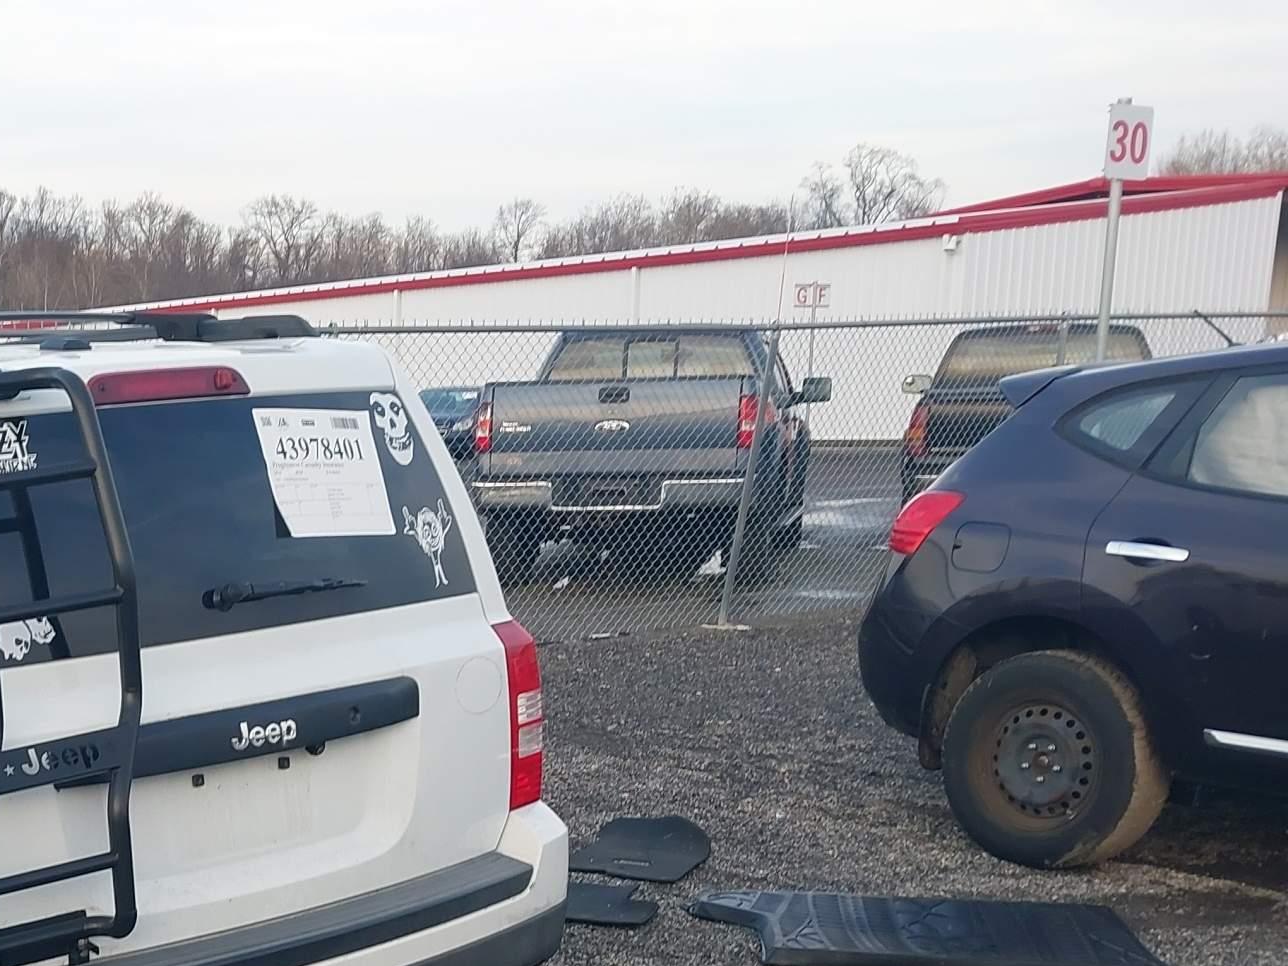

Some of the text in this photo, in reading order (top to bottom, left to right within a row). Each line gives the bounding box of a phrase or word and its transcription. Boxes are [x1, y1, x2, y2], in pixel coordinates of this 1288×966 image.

[1110, 120, 1148, 164] 30
[797, 287, 808, 304] G
[818, 287, 826, 304] F
[276, 437, 364, 461] 43978401
[231, 719, 297, 751] Jeep
[21, 743, 100, 776] Jeep
